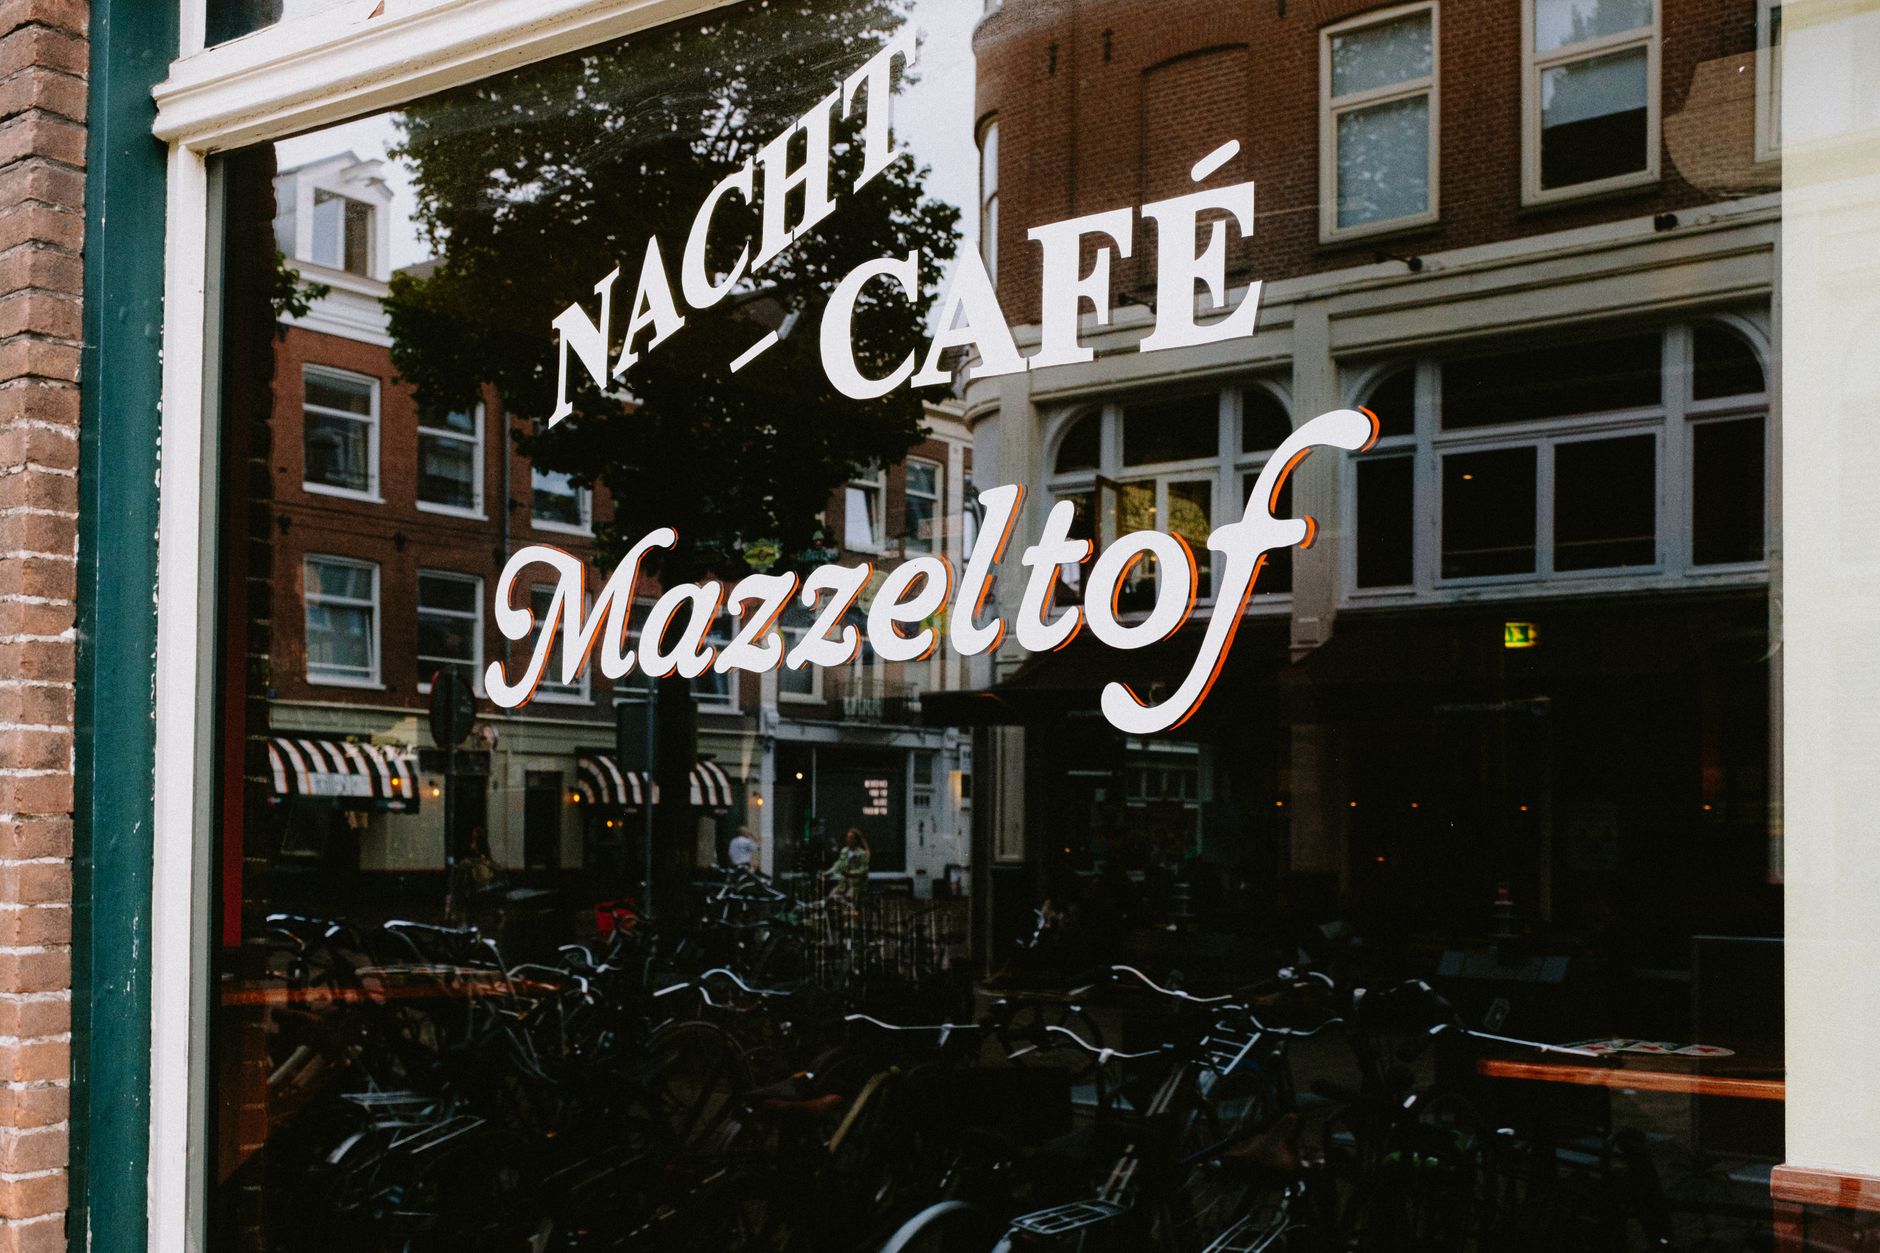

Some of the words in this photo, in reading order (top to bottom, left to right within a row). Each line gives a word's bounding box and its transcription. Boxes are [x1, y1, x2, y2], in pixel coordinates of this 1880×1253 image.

[548, 27, 918, 429] NACHT
[819, 139, 1263, 400] CAFÉ
[484, 408, 1381, 735] Mazzeltof
